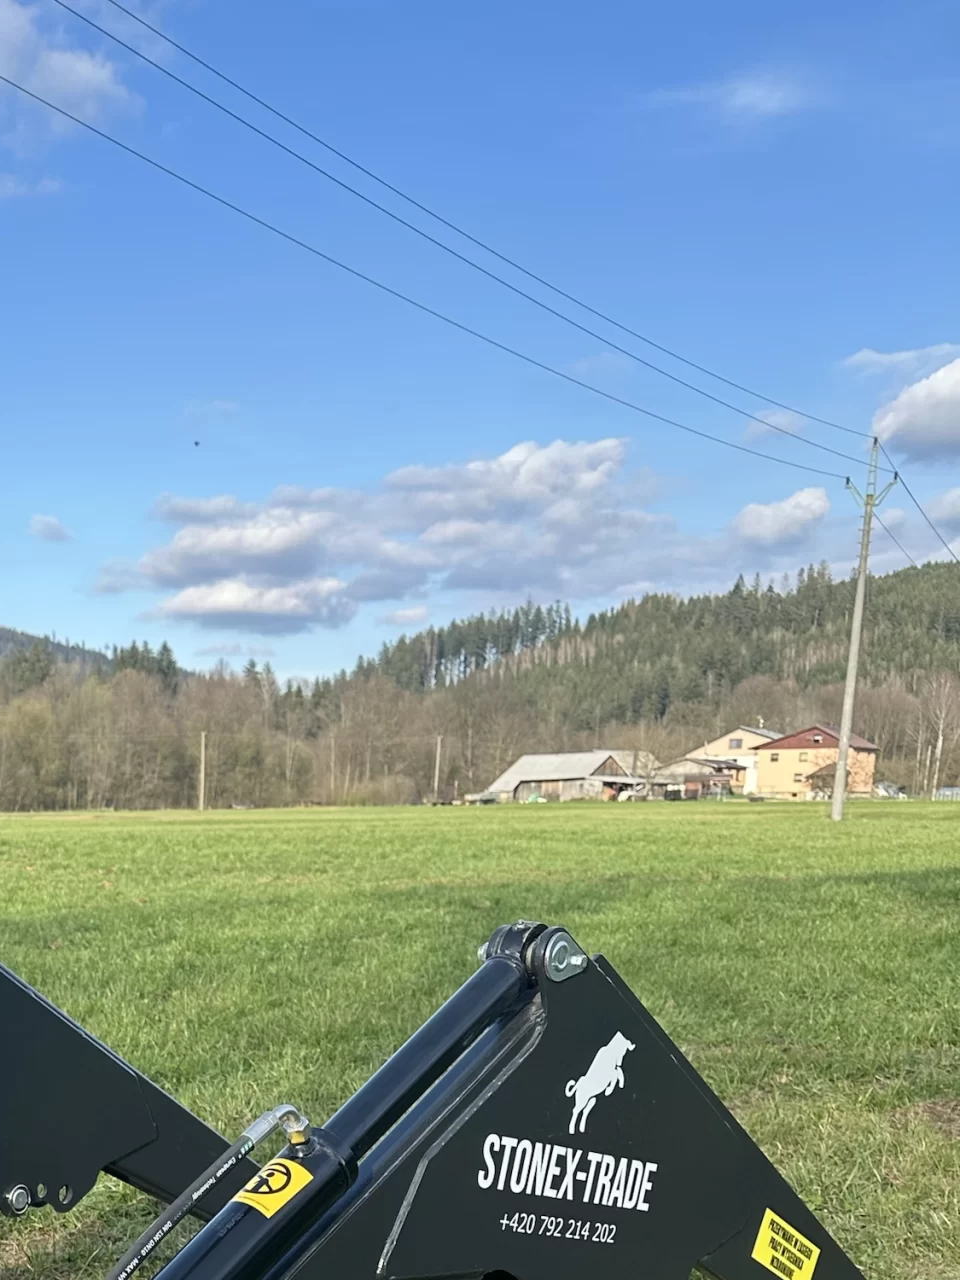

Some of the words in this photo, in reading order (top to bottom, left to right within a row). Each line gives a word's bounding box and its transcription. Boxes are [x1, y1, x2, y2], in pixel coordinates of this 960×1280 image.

[477, 1133, 658, 1212] STONEX-TRADE
[499, 1212, 536, 1235] +420
[538, 1216, 562, 1237] 792
[565, 1219, 590, 1241] 214
[591, 1223, 617, 1244] 202
[125, 1258, 139, 1273] MAX
